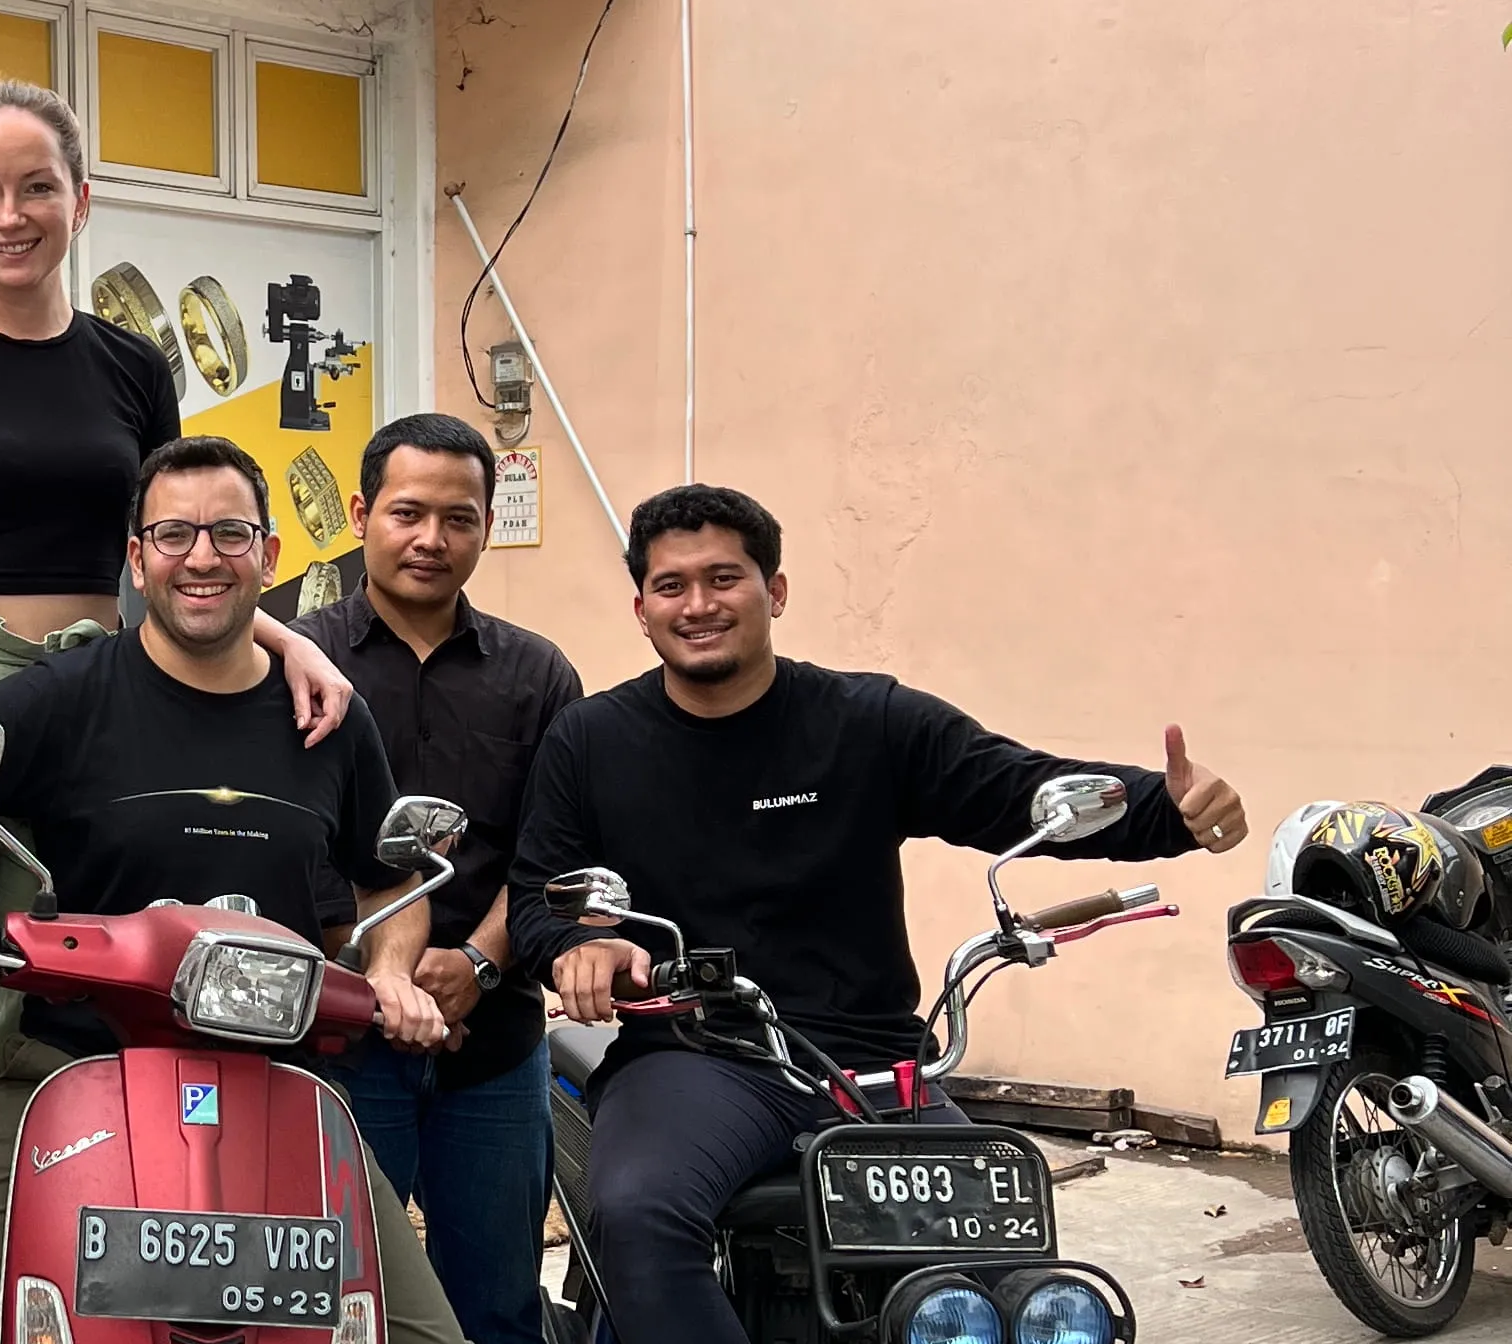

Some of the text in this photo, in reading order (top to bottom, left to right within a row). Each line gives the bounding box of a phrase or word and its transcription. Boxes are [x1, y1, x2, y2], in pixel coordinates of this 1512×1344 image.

[752, 792, 818, 810] BULUNMAZ
[1274, 996, 1307, 1007] HONDA
[1232, 1034, 1244, 1053] L
[1258, 1022, 1307, 1048] 3711
[31, 1129, 117, 1175] Vespa
[822, 1164, 1034, 1204] L 6683 EL
[85, 1215, 336, 1271] B 6625 VRC
